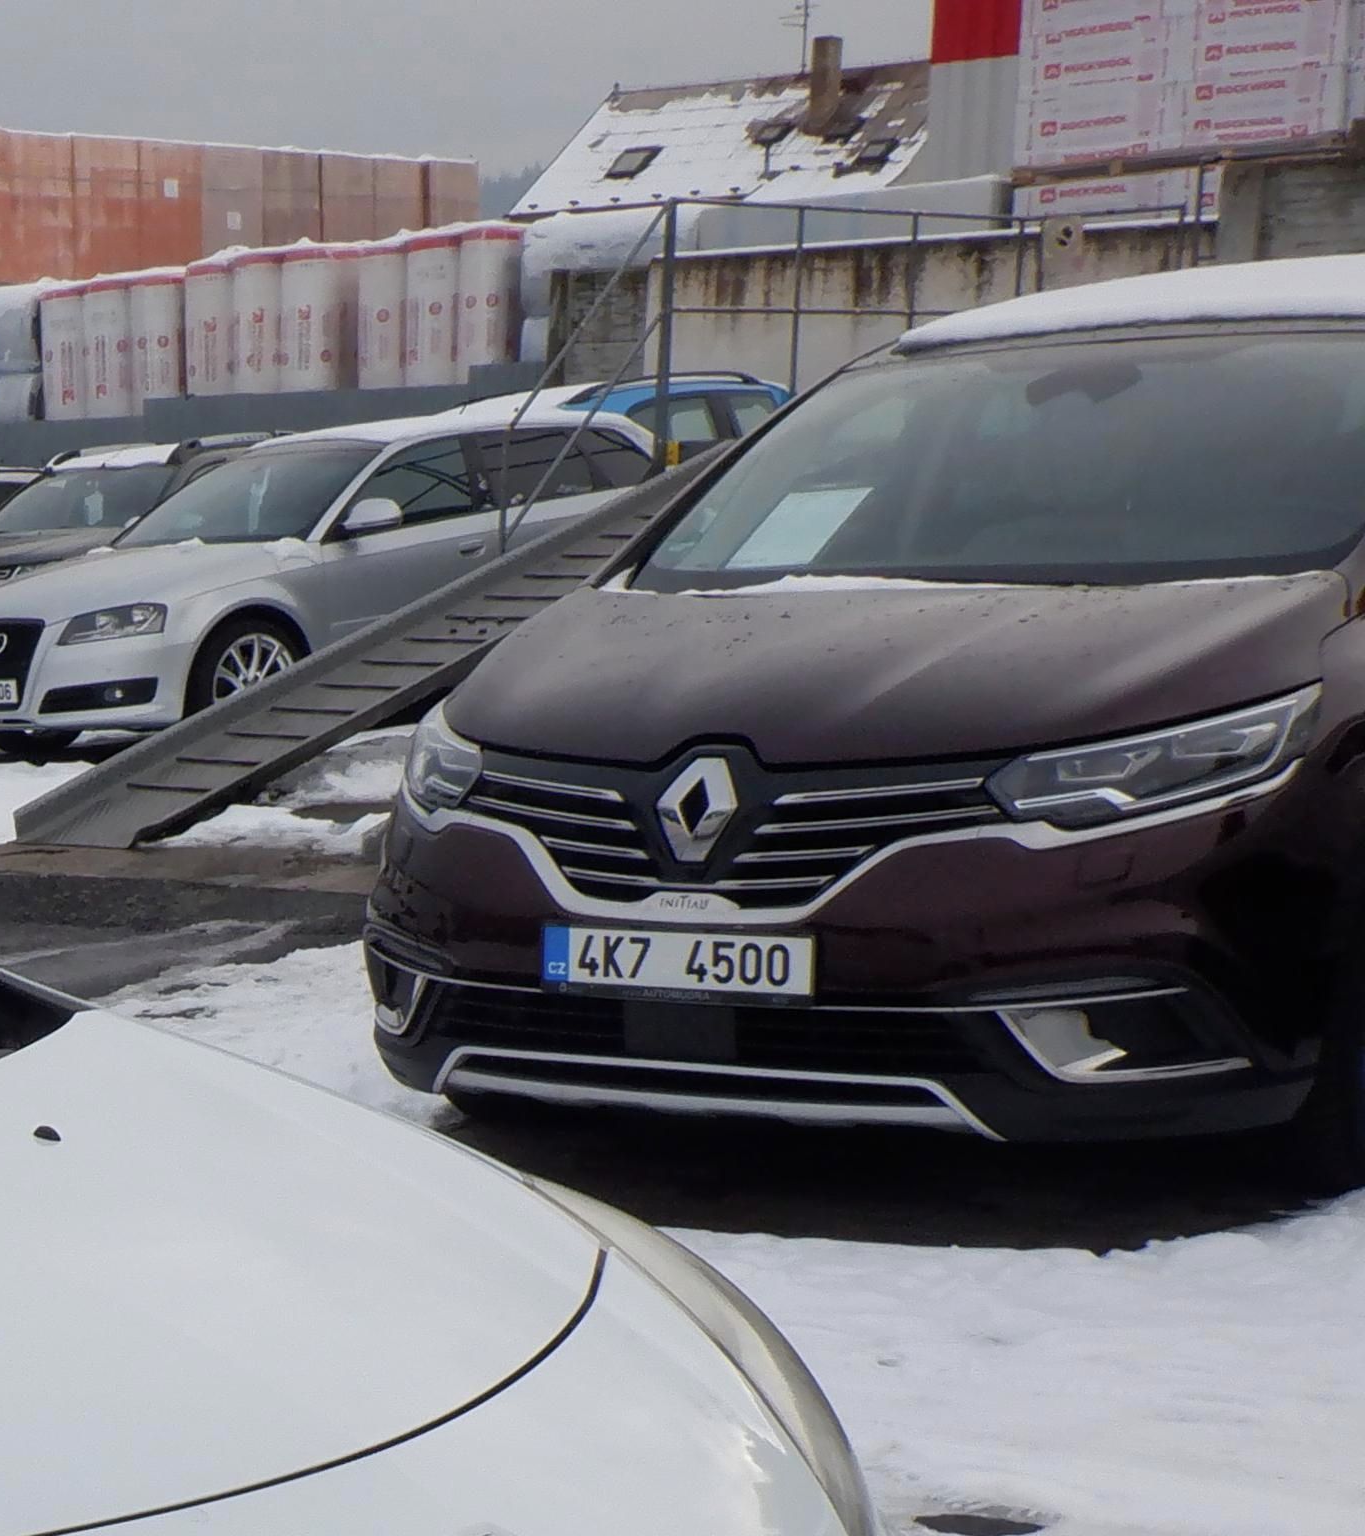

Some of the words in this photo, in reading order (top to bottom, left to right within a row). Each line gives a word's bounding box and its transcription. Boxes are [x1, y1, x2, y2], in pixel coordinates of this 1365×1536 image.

[548, 962, 567, 975] CZ
[578, 934, 651, 979] 4K7
[685, 940, 790, 987] 4500
